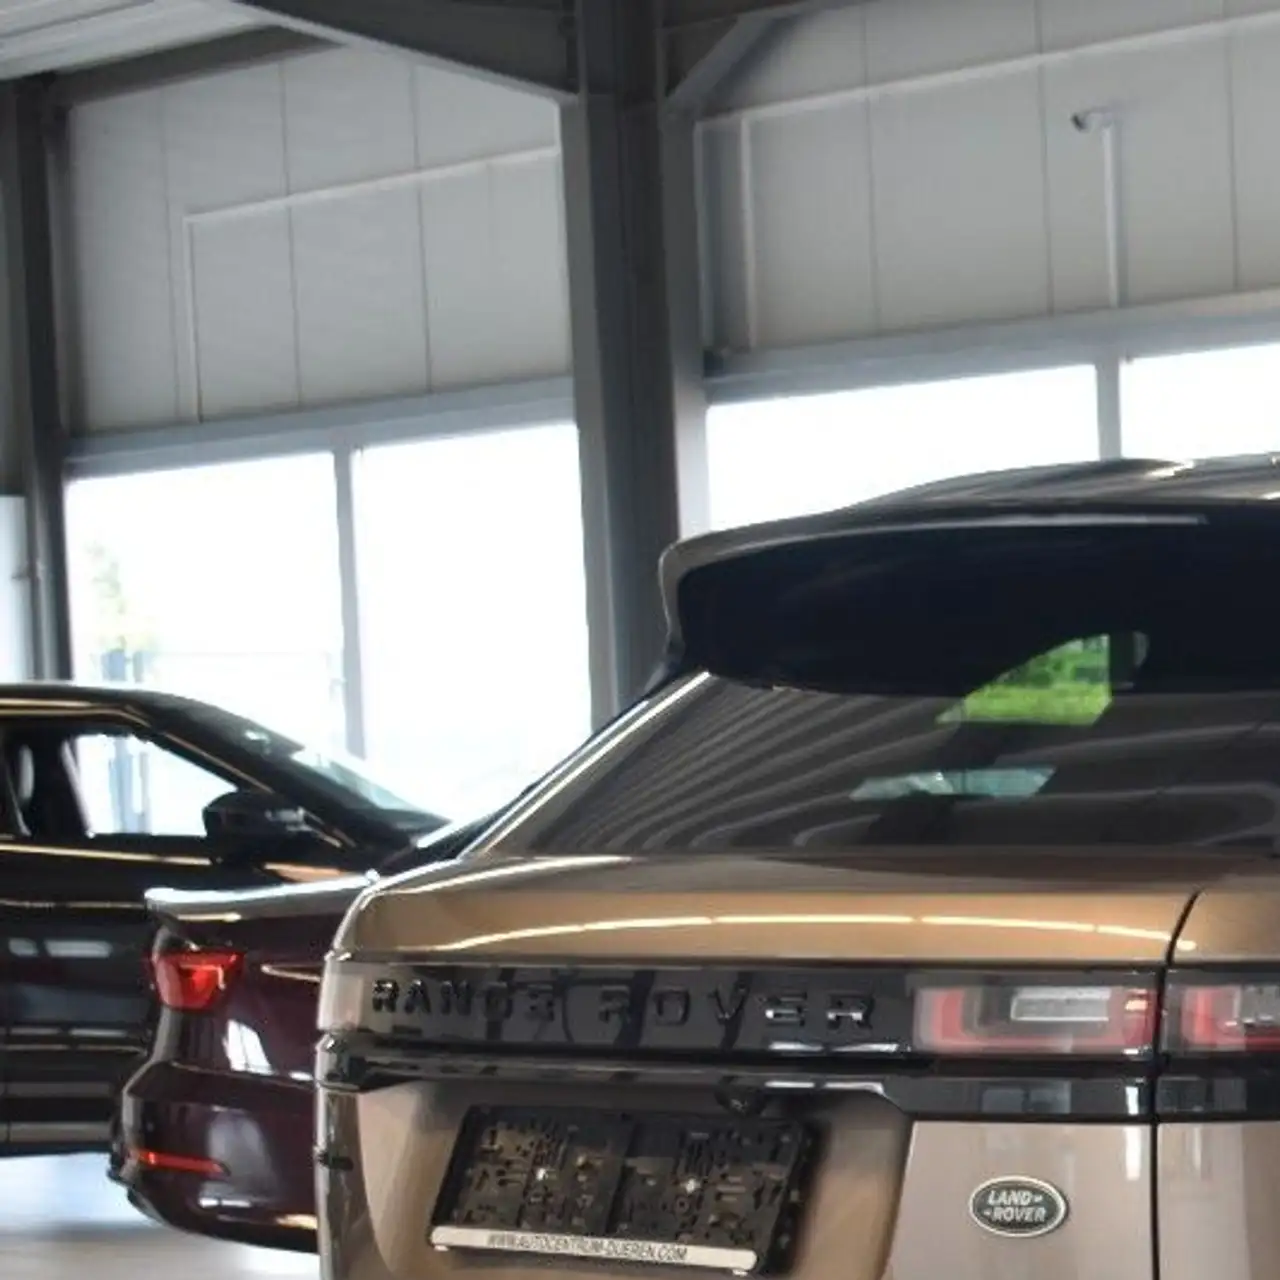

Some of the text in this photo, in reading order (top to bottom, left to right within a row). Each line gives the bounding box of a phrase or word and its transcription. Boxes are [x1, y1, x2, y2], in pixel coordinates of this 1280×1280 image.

[372, 979, 875, 1030] RANGE ROVER
[987, 1189, 1034, 1206] LAND
[991, 1205, 1048, 1223] ROVER
